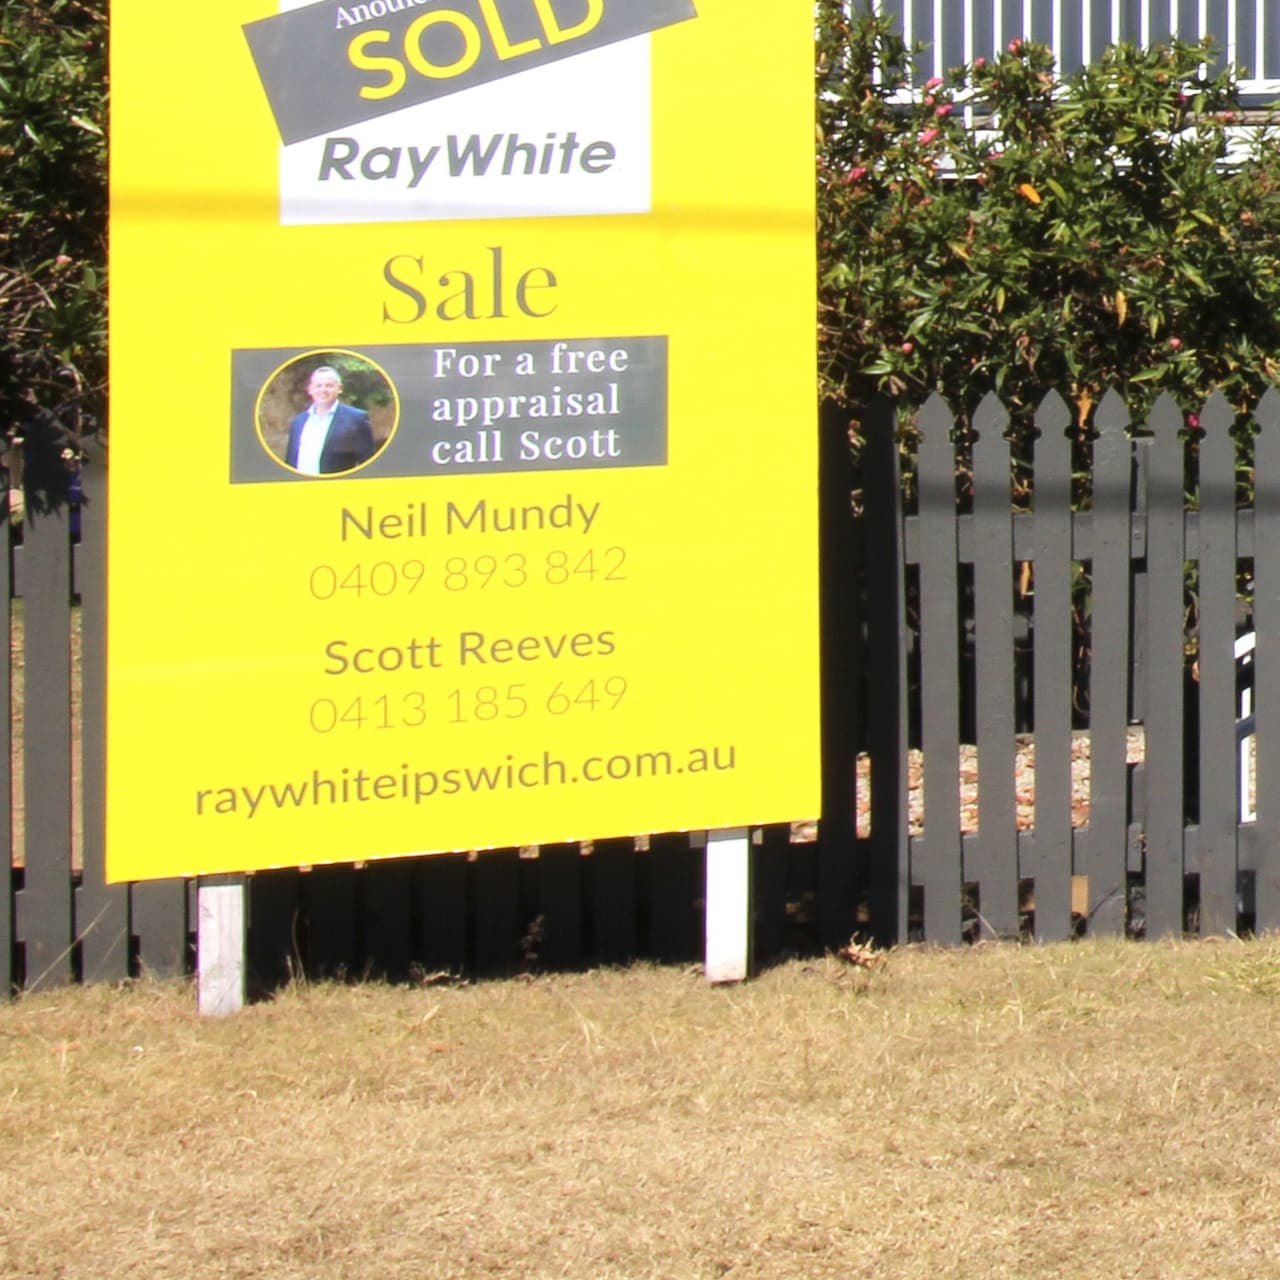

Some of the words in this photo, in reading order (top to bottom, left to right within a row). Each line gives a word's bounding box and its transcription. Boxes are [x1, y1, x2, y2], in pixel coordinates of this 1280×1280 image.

[383, 247, 558, 324] Sale
[435, 348, 501, 377] For
[515, 353, 535, 374] a
[551, 344, 629, 373] free
[432, 386, 620, 427] appraisal
[432, 433, 502, 465] call
[521, 428, 621, 460] Scott
[341, 504, 427, 541] Neil
[446, 494, 600, 535] Mundy
[309, 561, 426, 600] 0409
[444, 555, 528, 592] 893
[546, 547, 627, 585] 842
[324, 638, 441, 676] Scott
[460, 628, 616, 667] Reeves
[309, 693, 427, 733] 0413
[448, 685, 528, 724] 185
[546, 677, 627, 715] 649
[196, 745, 736, 819] raywhiteipswich.com.au
